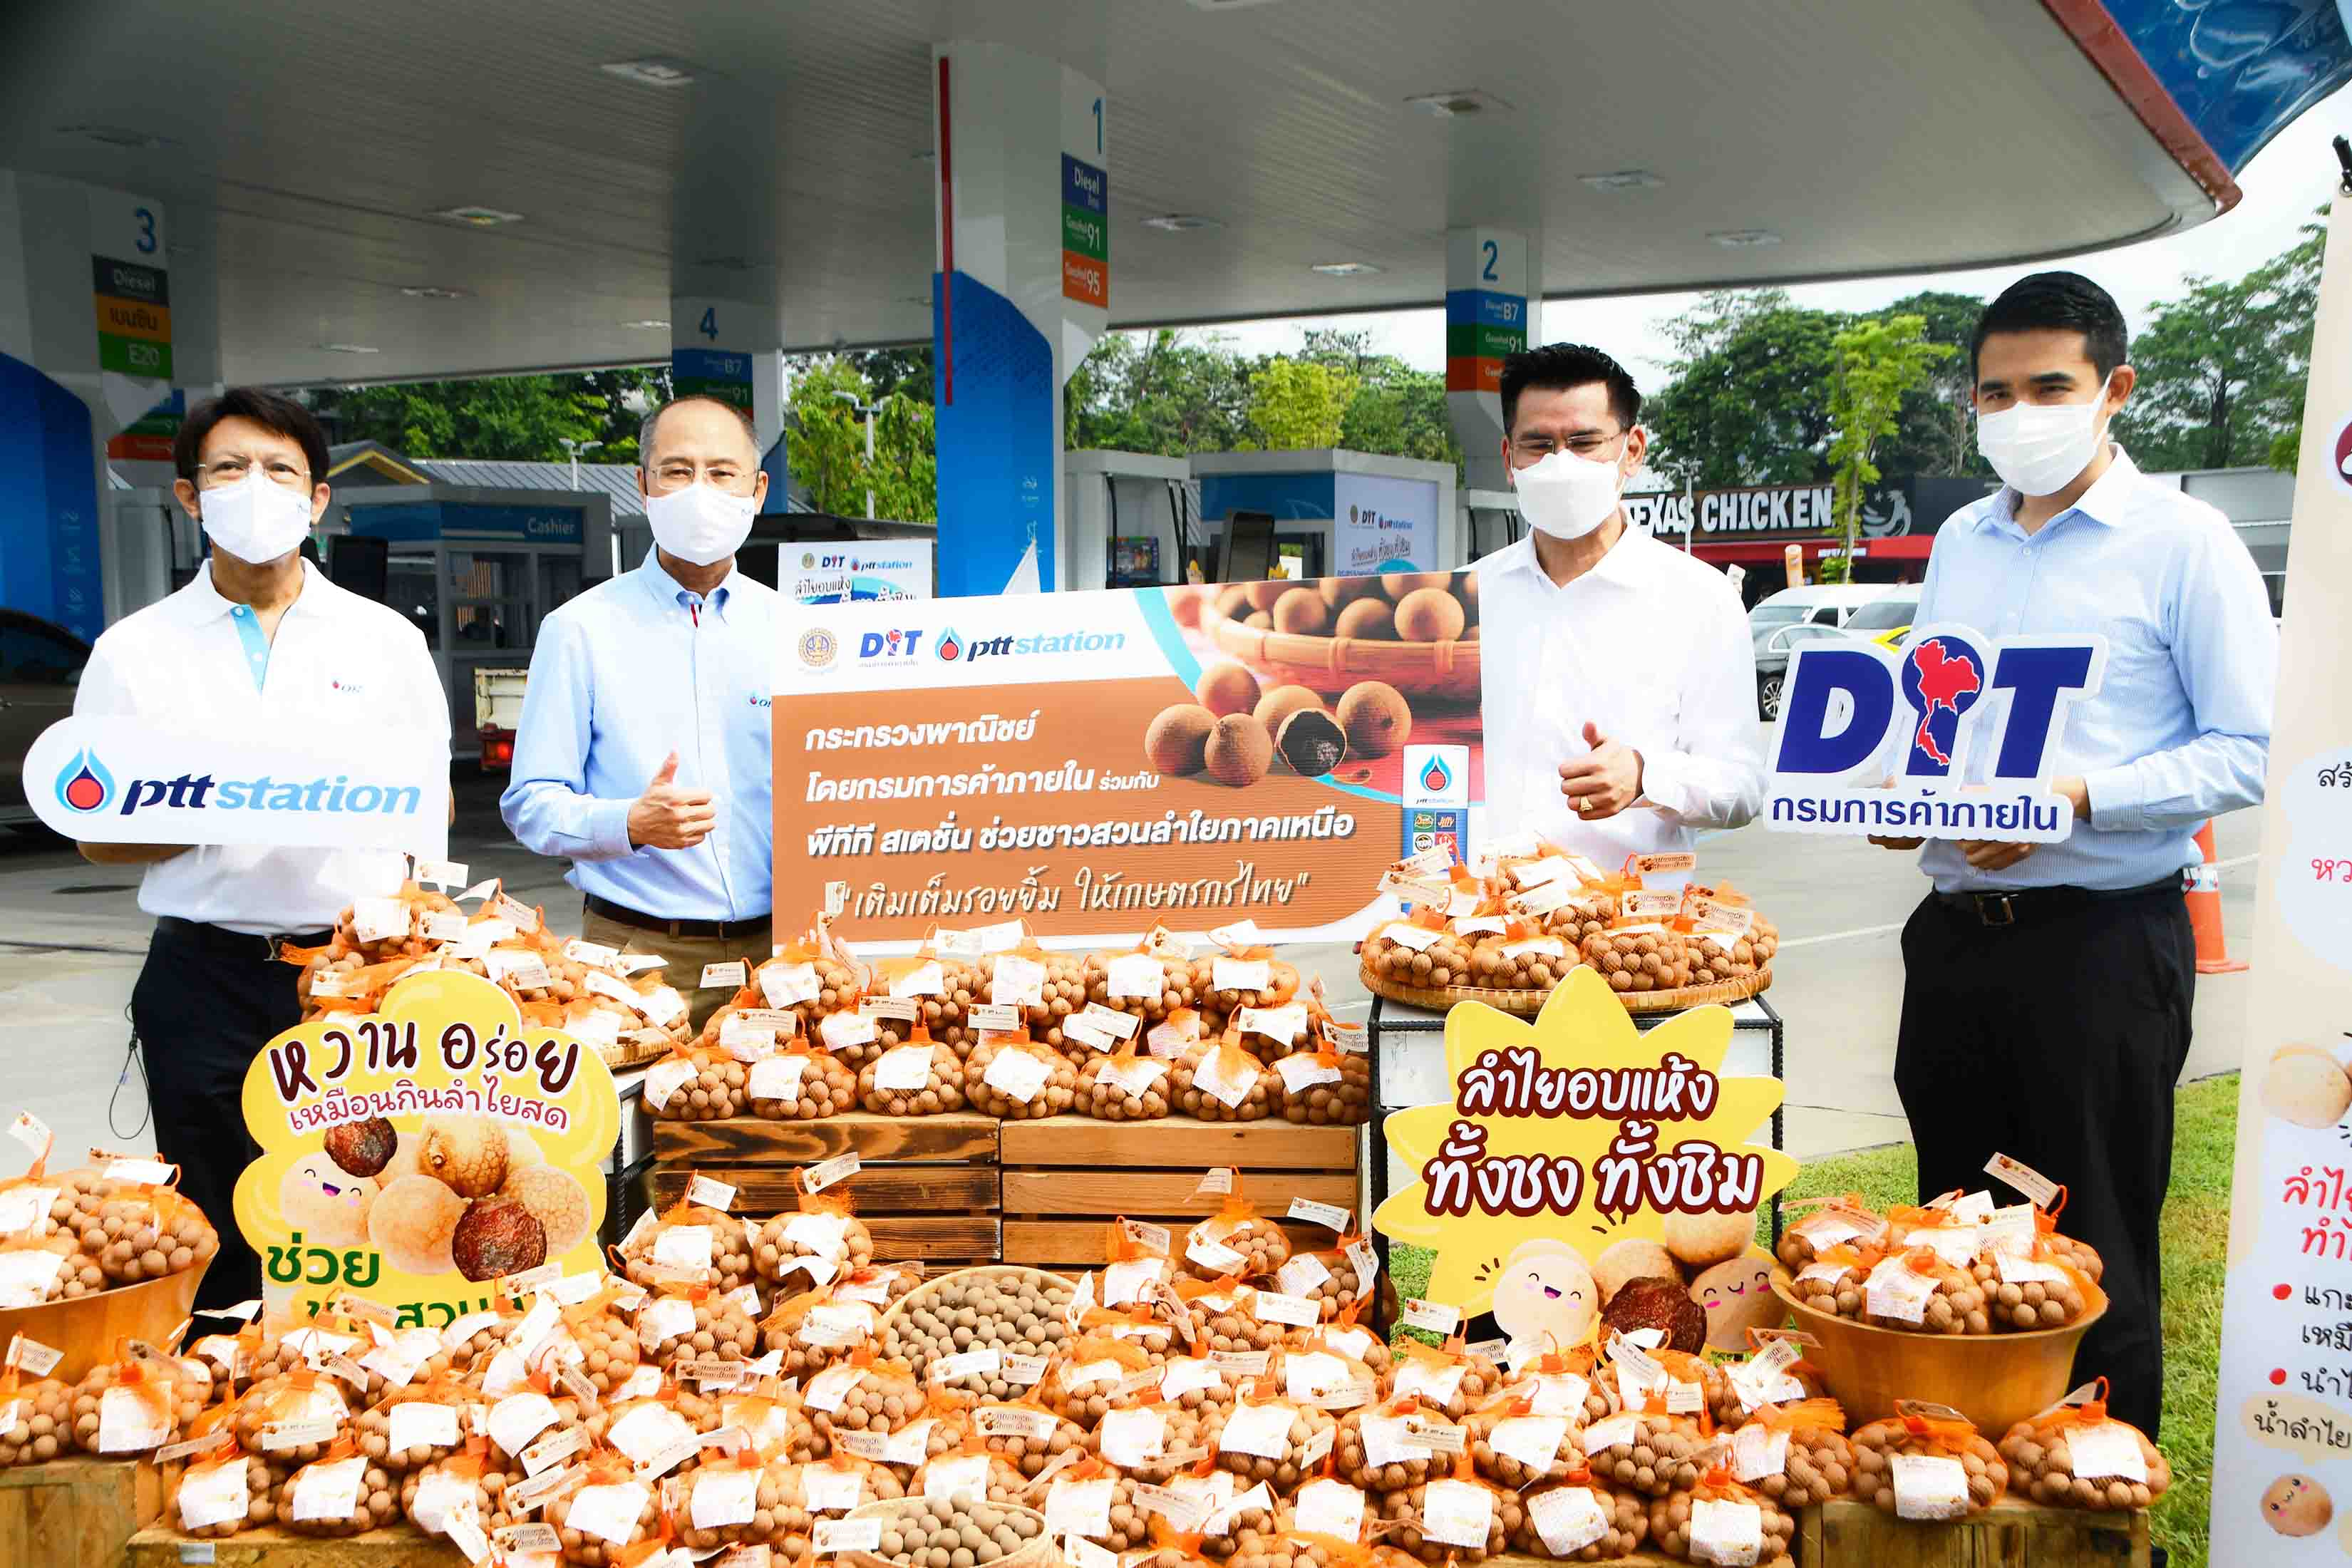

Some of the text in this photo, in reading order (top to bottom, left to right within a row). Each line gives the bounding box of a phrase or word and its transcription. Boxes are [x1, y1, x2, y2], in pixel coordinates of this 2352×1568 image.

[1093, 98, 1103, 155] 1
[1073, 166, 1100, 195] Diesel
[135, 207, 157, 253] 3
[1088, 223, 1100, 251] 91
[113, 268, 156, 291] Diesel
[1482, 239, 1498, 281] 2
[1087, 269, 1100, 297] 95
[699, 307, 718, 343] 4
[1503, 301, 1519, 321] B7
[128, 344, 160, 368] E20
[1508, 336, 1522, 353] 91
[527, 517, 575, 535] Cashier
[1701, 488, 1835, 532] CHICKEN
[966, 630, 1126, 661] ptt station
[805, 709, 1041, 751] กระทรวงพาณิชย์
[120, 774, 421, 816] ptt station
[805, 760, 1160, 803] โดยกรมการค้าภายใน ร่วมกับ
[1772, 789, 2058, 831] กรมการค้าภายใน
[806, 821, 877, 856] พีทีที
[879, 810, 972, 853] สเตชั่น
[1075, 860, 1310, 911] ให้เกษตรกรไทย"
[269, 1021, 579, 1102] หวาน อร่อย
[1461, 1049, 1713, 1113] ลำไยอบแห้ง
[289, 1074, 568, 1130] เหมือนกินลำไยสด
[1427, 1121, 1758, 1210] ทั้งชง ทั้งชิม
[267, 1232, 381, 1289] ช่วย
